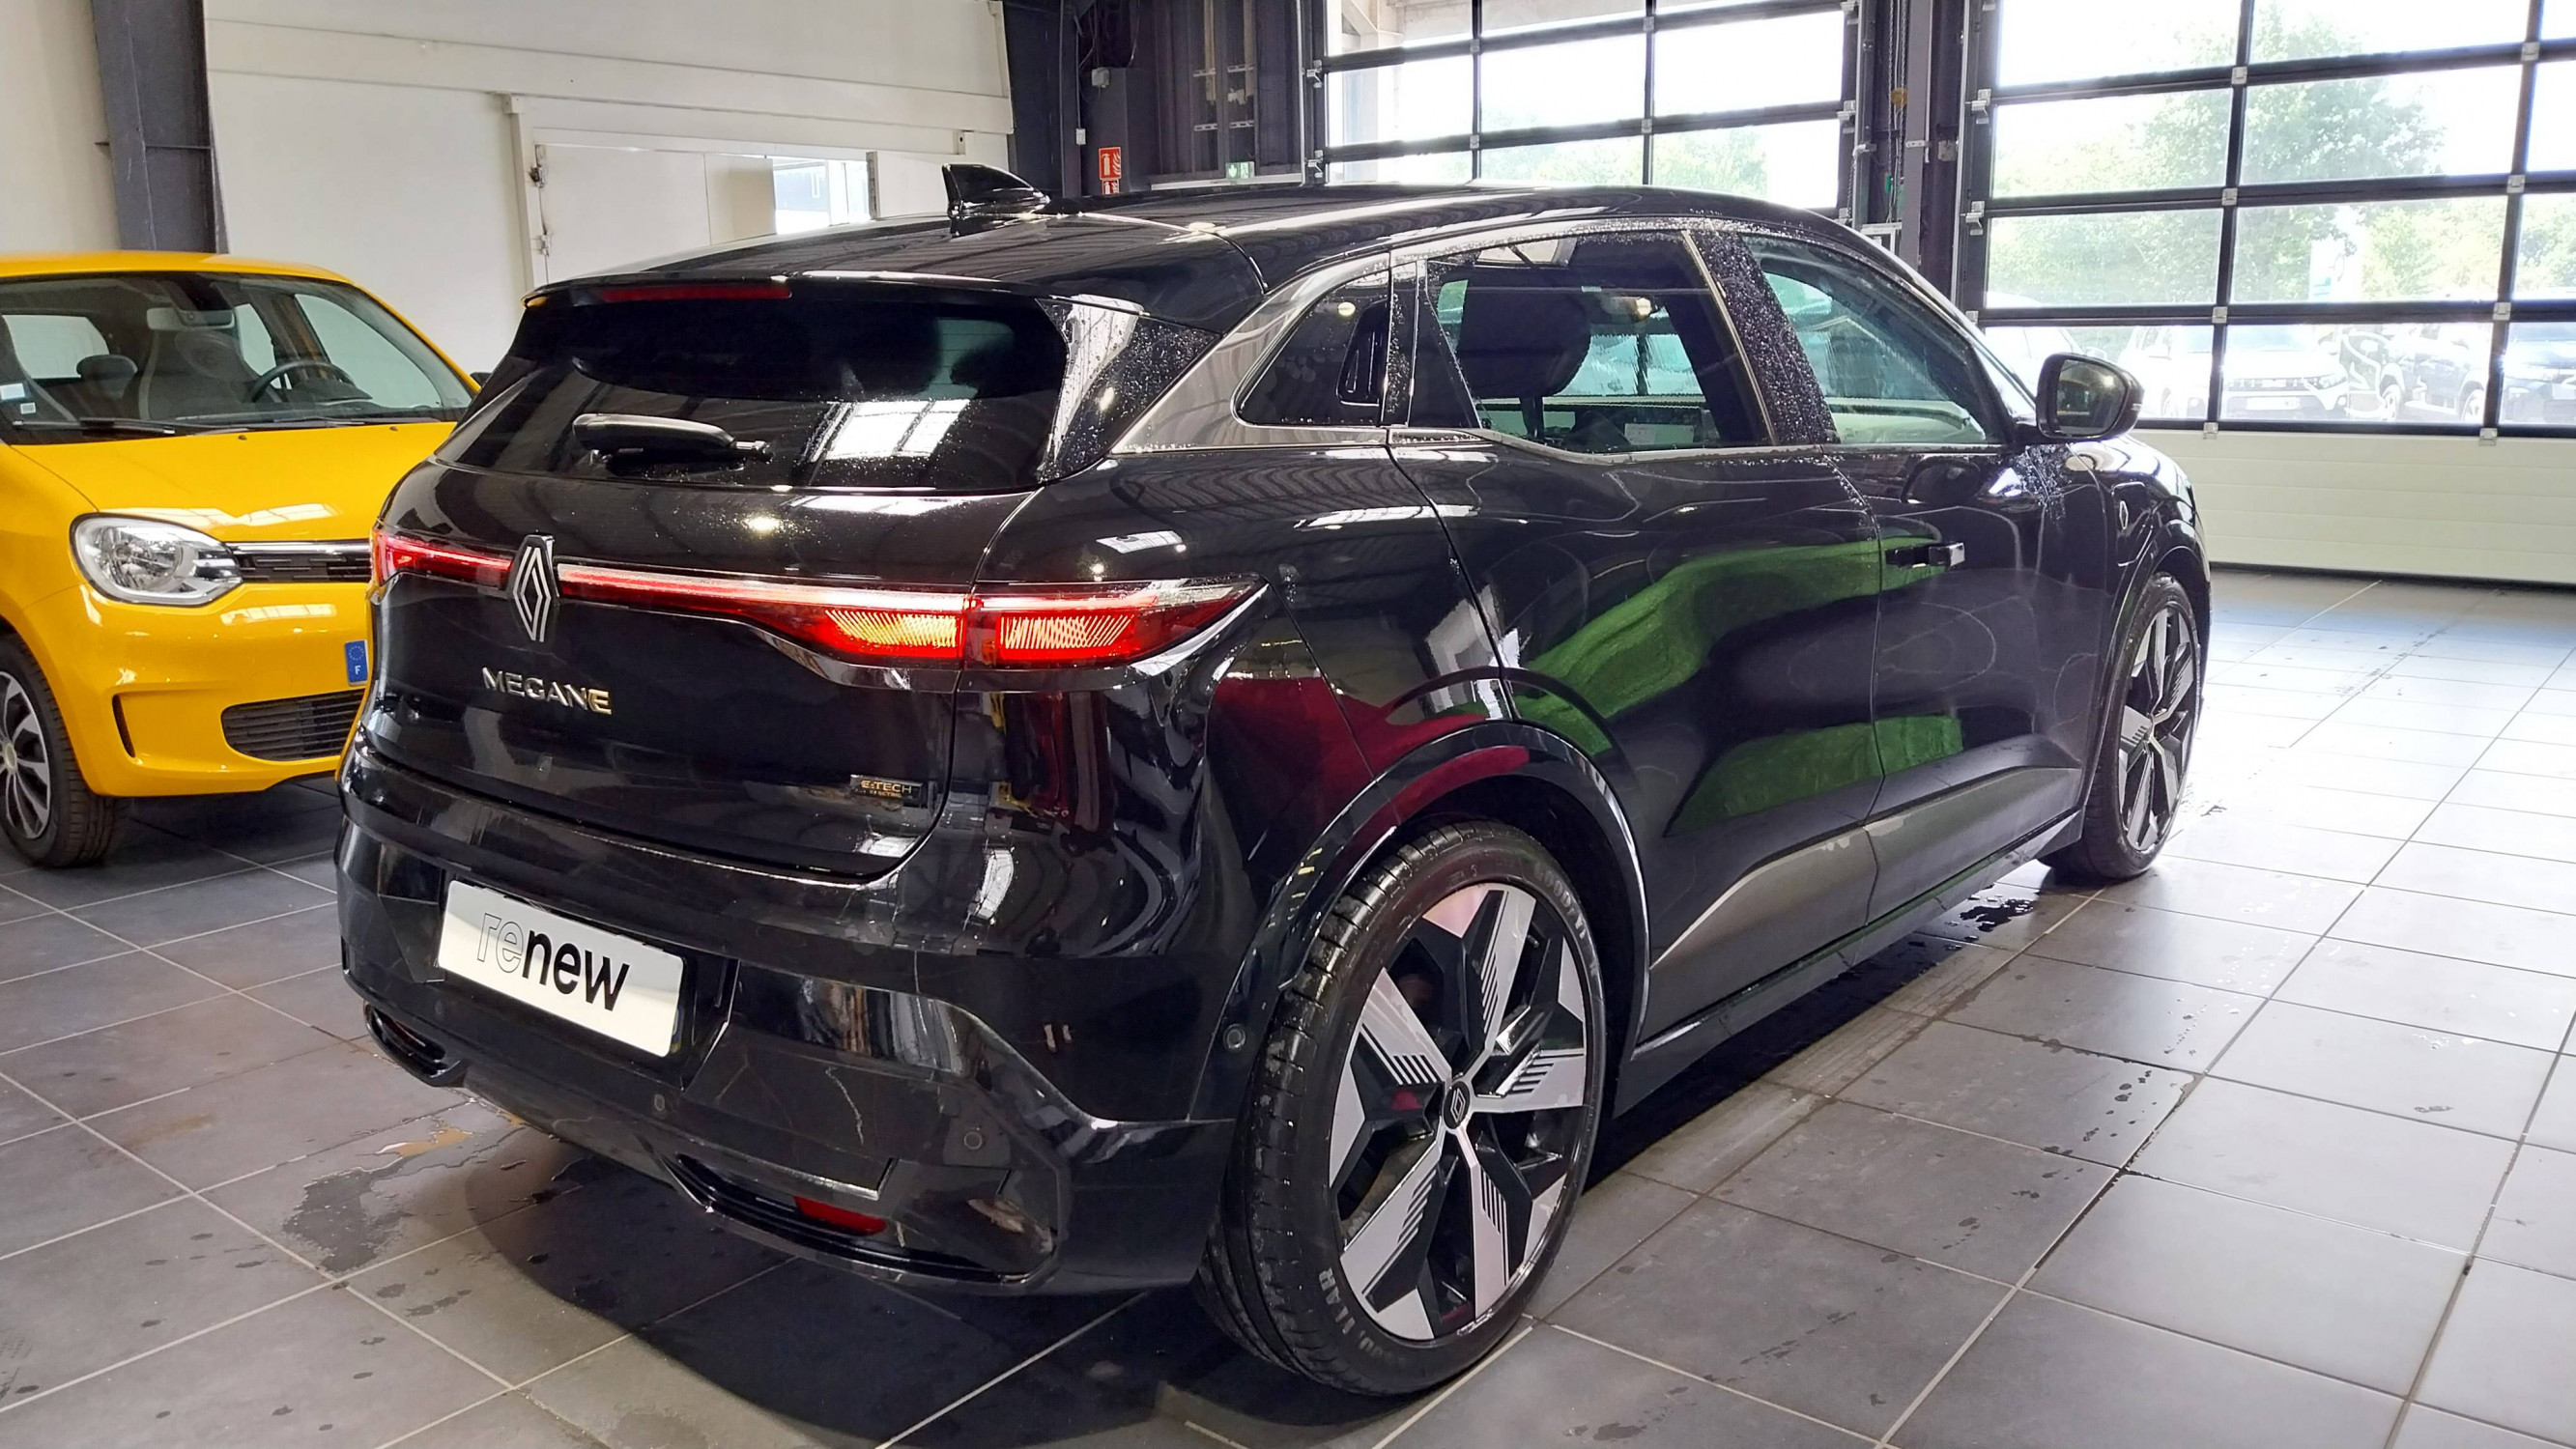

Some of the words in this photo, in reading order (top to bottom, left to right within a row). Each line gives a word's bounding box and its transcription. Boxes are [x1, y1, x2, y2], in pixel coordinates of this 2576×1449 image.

[355, 665, 361, 675] F
[482, 667, 612, 715] MEGANE
[477, 913, 631, 1011] renew
